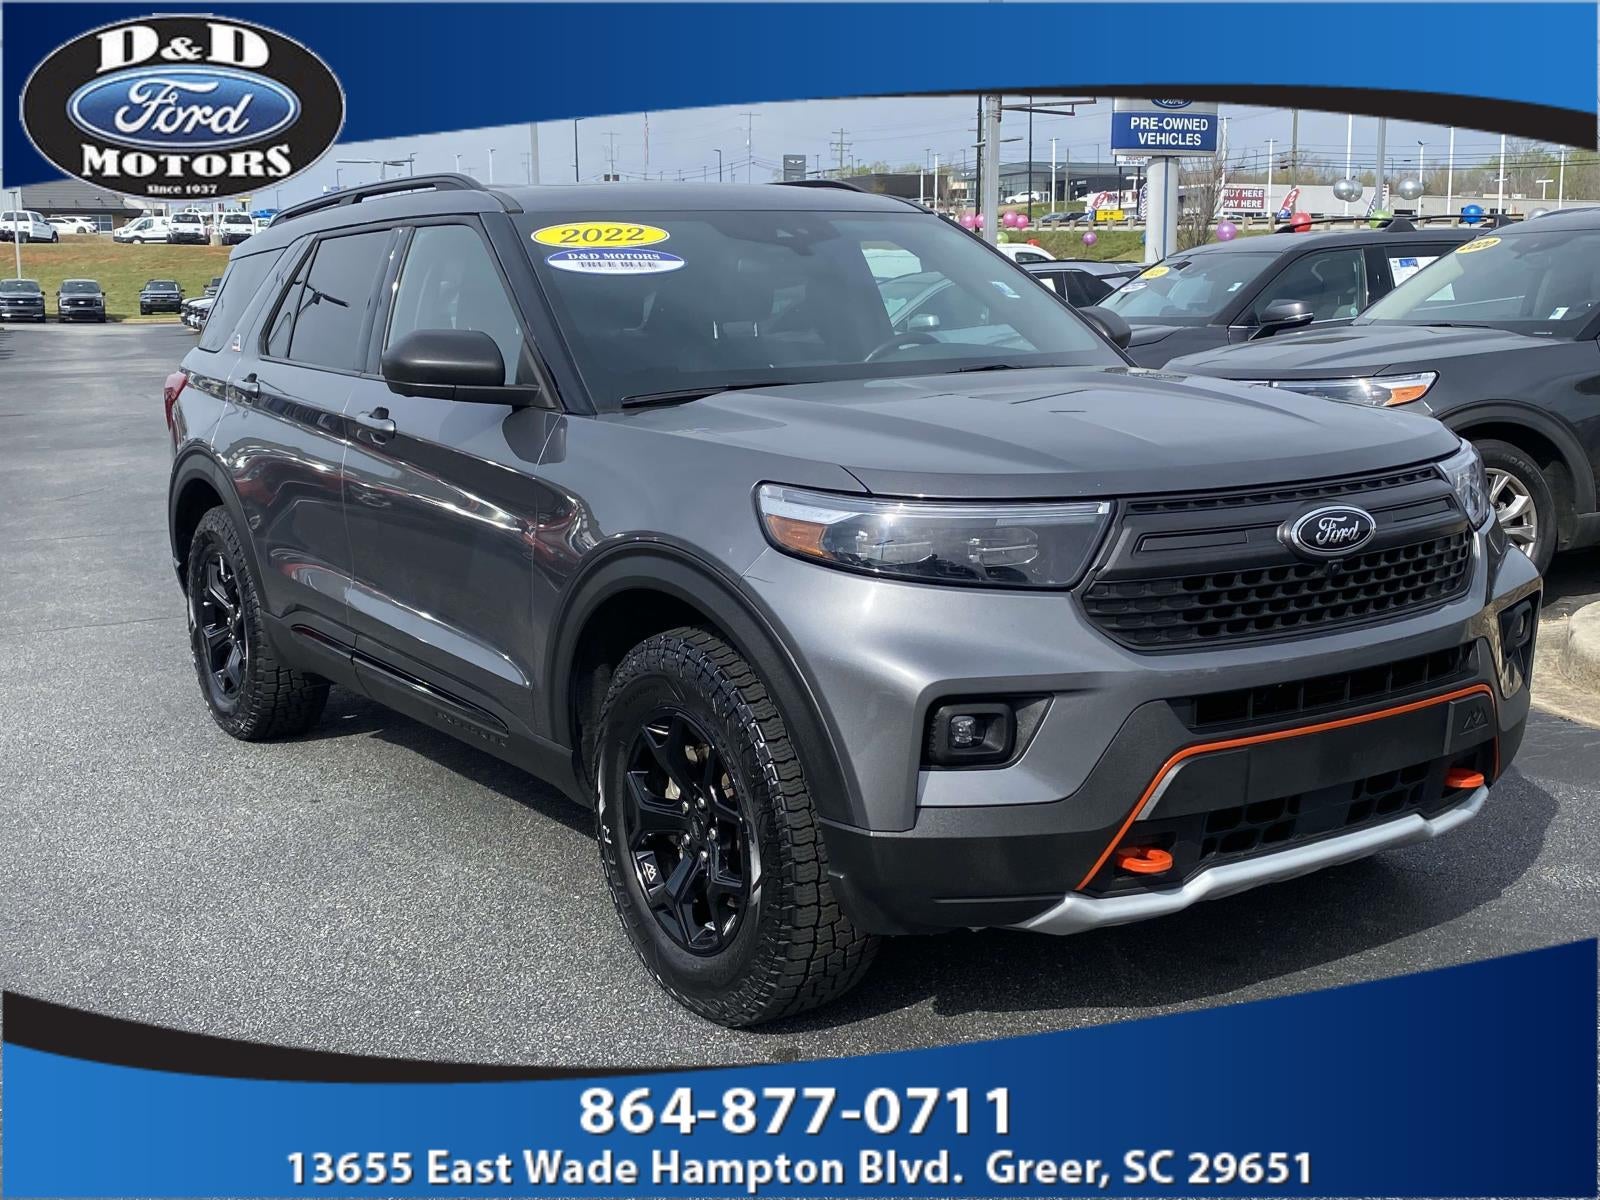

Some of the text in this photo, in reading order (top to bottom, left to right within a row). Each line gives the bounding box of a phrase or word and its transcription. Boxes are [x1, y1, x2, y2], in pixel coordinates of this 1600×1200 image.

[1130, 117, 1208, 131] PRE-OWNED
[1138, 132, 1202, 146] VEHICLES
[1242, 189, 1264, 198] HERE
[1224, 199, 1262, 208] PAY HERE
[560, 228, 645, 243] 2022
[567, 252, 661, 260] D&D MOTORS
[1315, 516, 1360, 545] Ford
